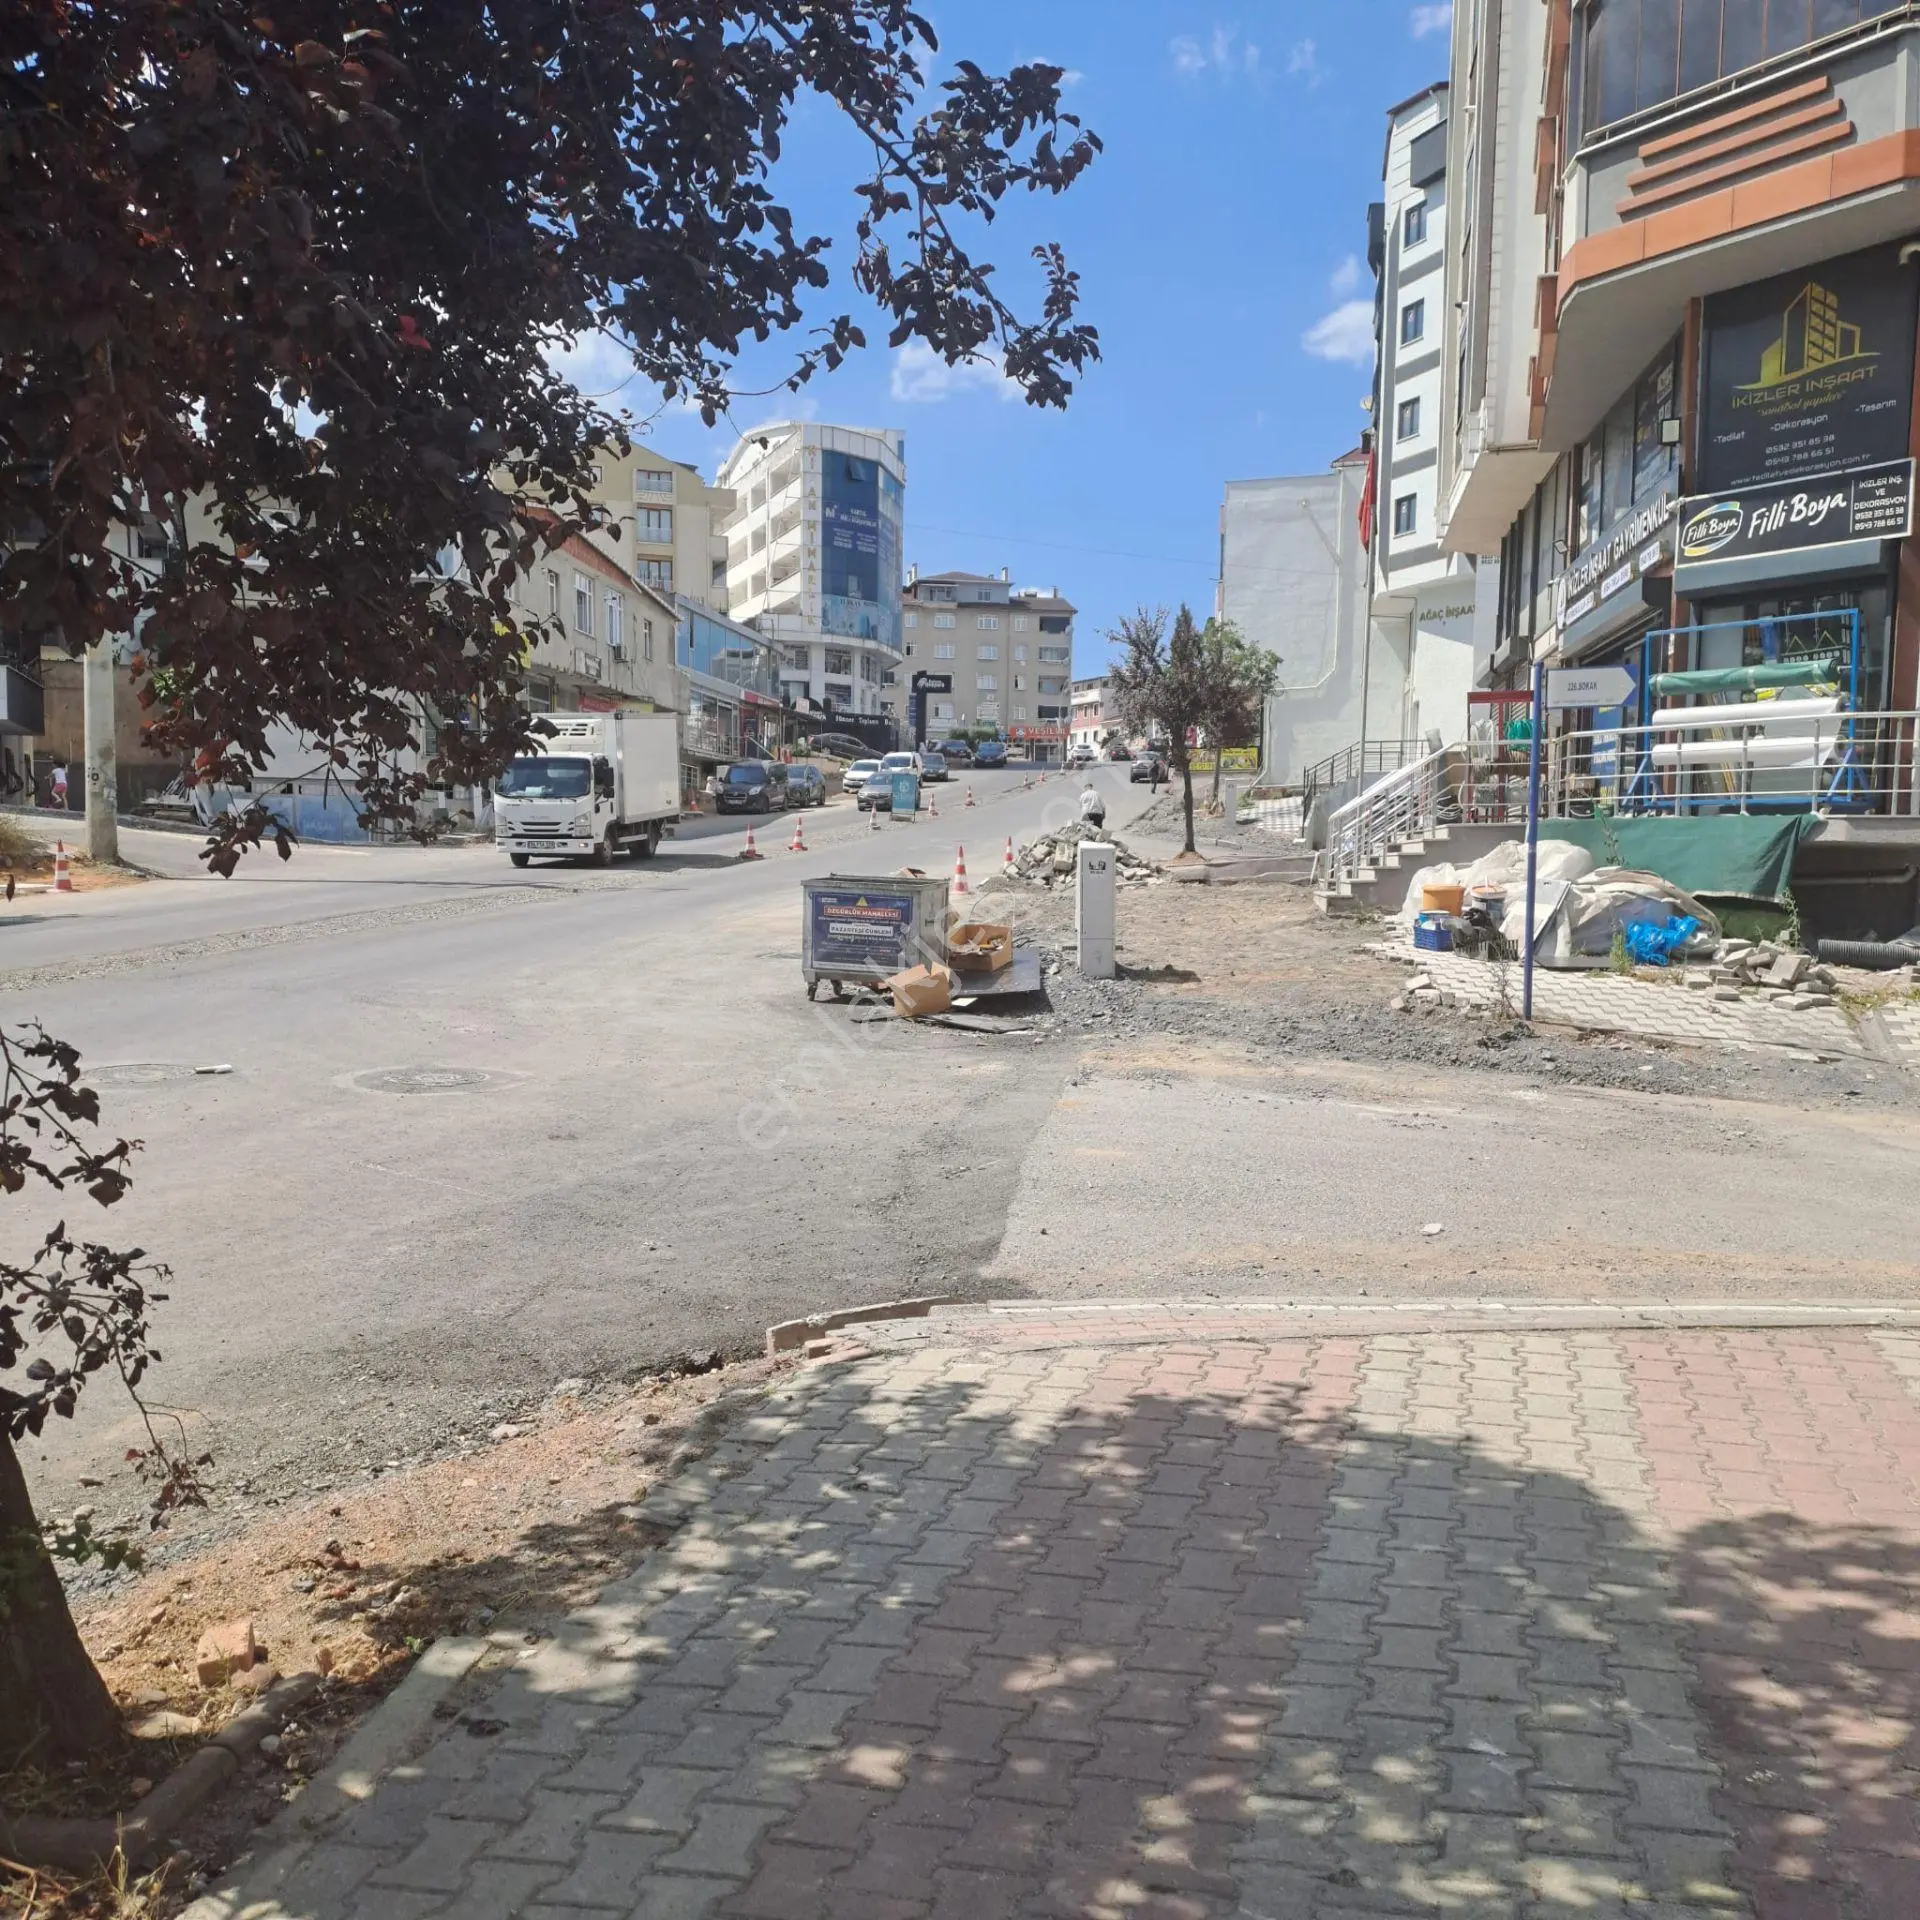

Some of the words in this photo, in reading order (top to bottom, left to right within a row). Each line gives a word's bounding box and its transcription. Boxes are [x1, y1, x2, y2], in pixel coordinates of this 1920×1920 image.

[1875, 487, 1886, 496] VE
[1853, 495, 1907, 510] DEKORASYON
[1748, 499, 1788, 538] Filli
[1790, 493, 1847, 526] Boya
[1686, 524, 1708, 542] Filli
[1708, 517, 1739, 536] Boya
